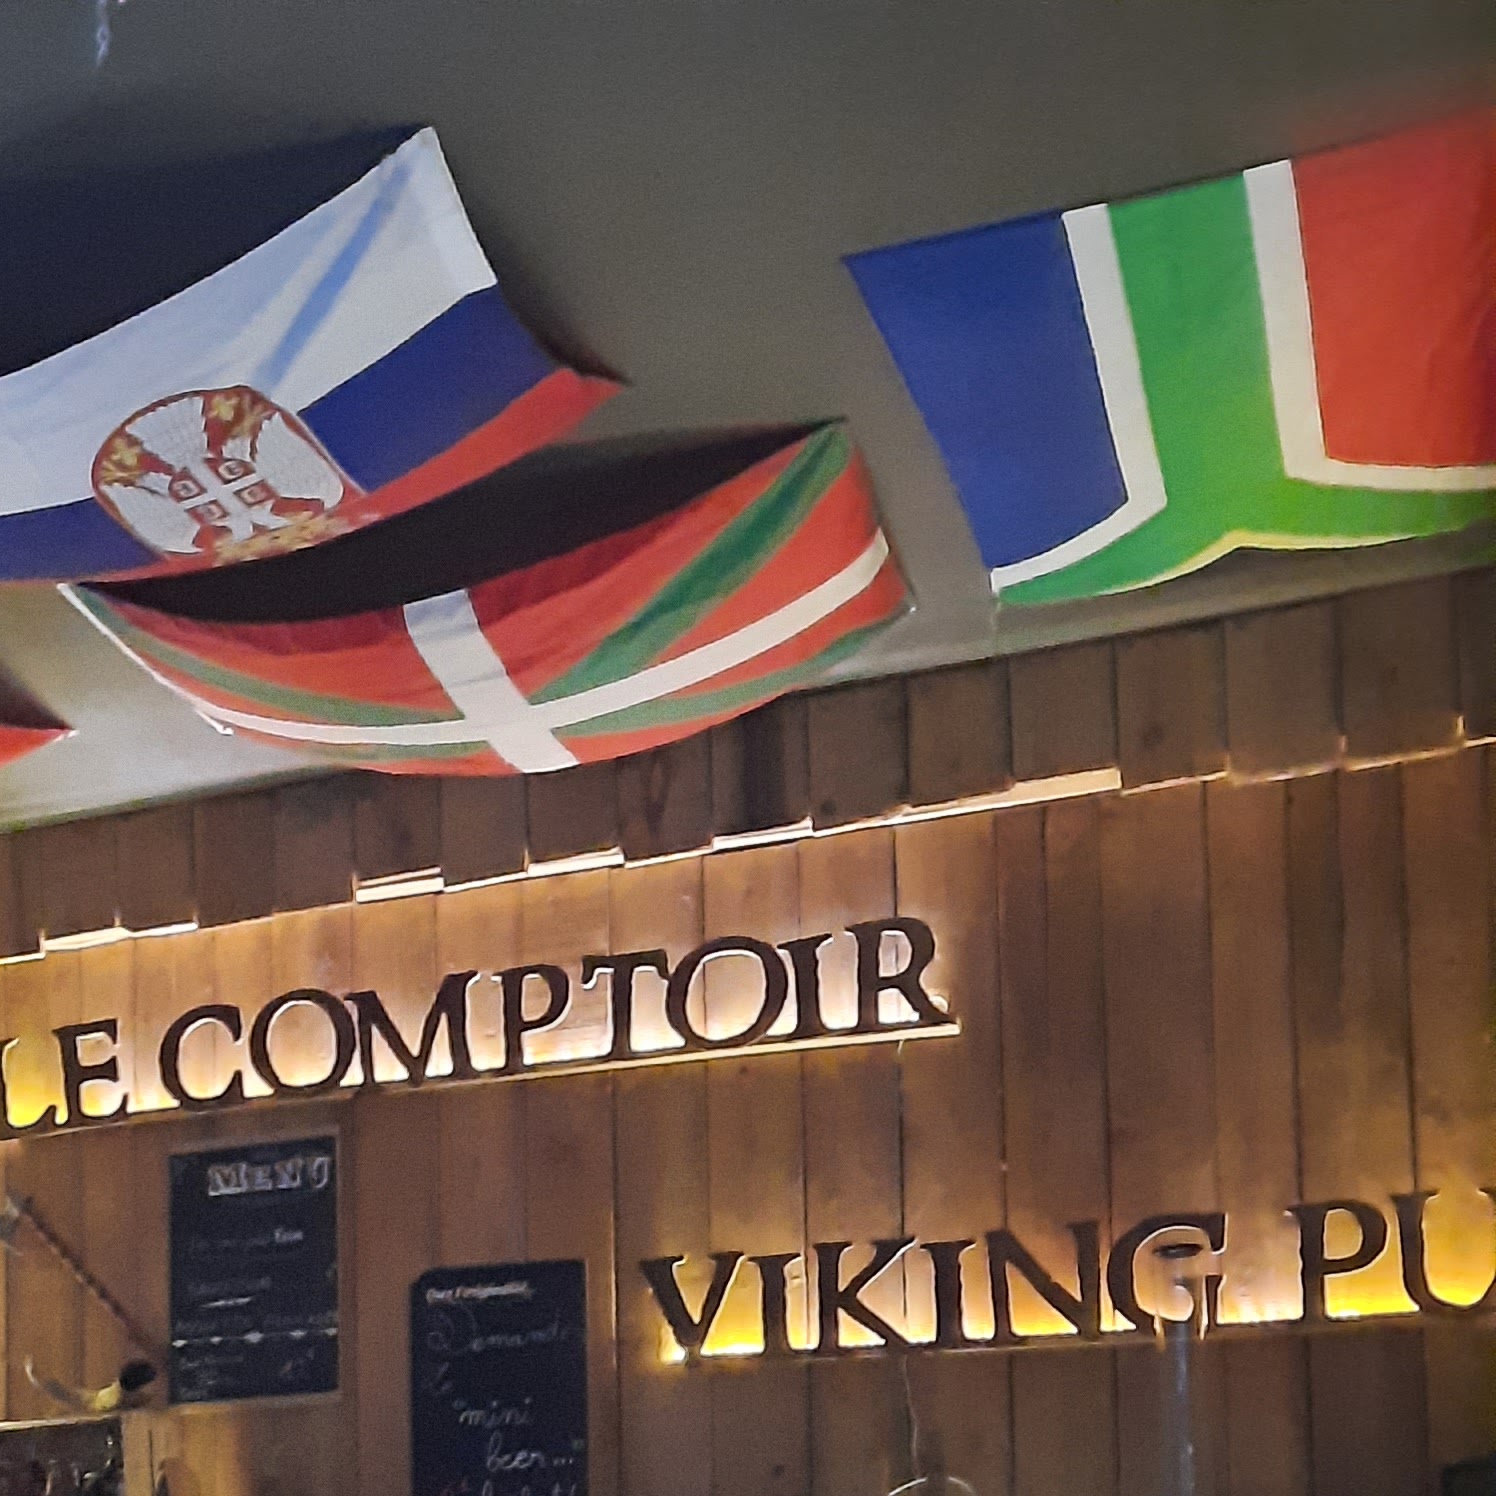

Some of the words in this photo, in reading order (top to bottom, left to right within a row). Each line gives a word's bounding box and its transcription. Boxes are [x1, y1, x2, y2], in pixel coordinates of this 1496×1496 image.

[159, 917, 951, 1111] COMPTOIR
[208, 1156, 331, 1196] MENU
[640, 1212, 1228, 1362] VIKING
